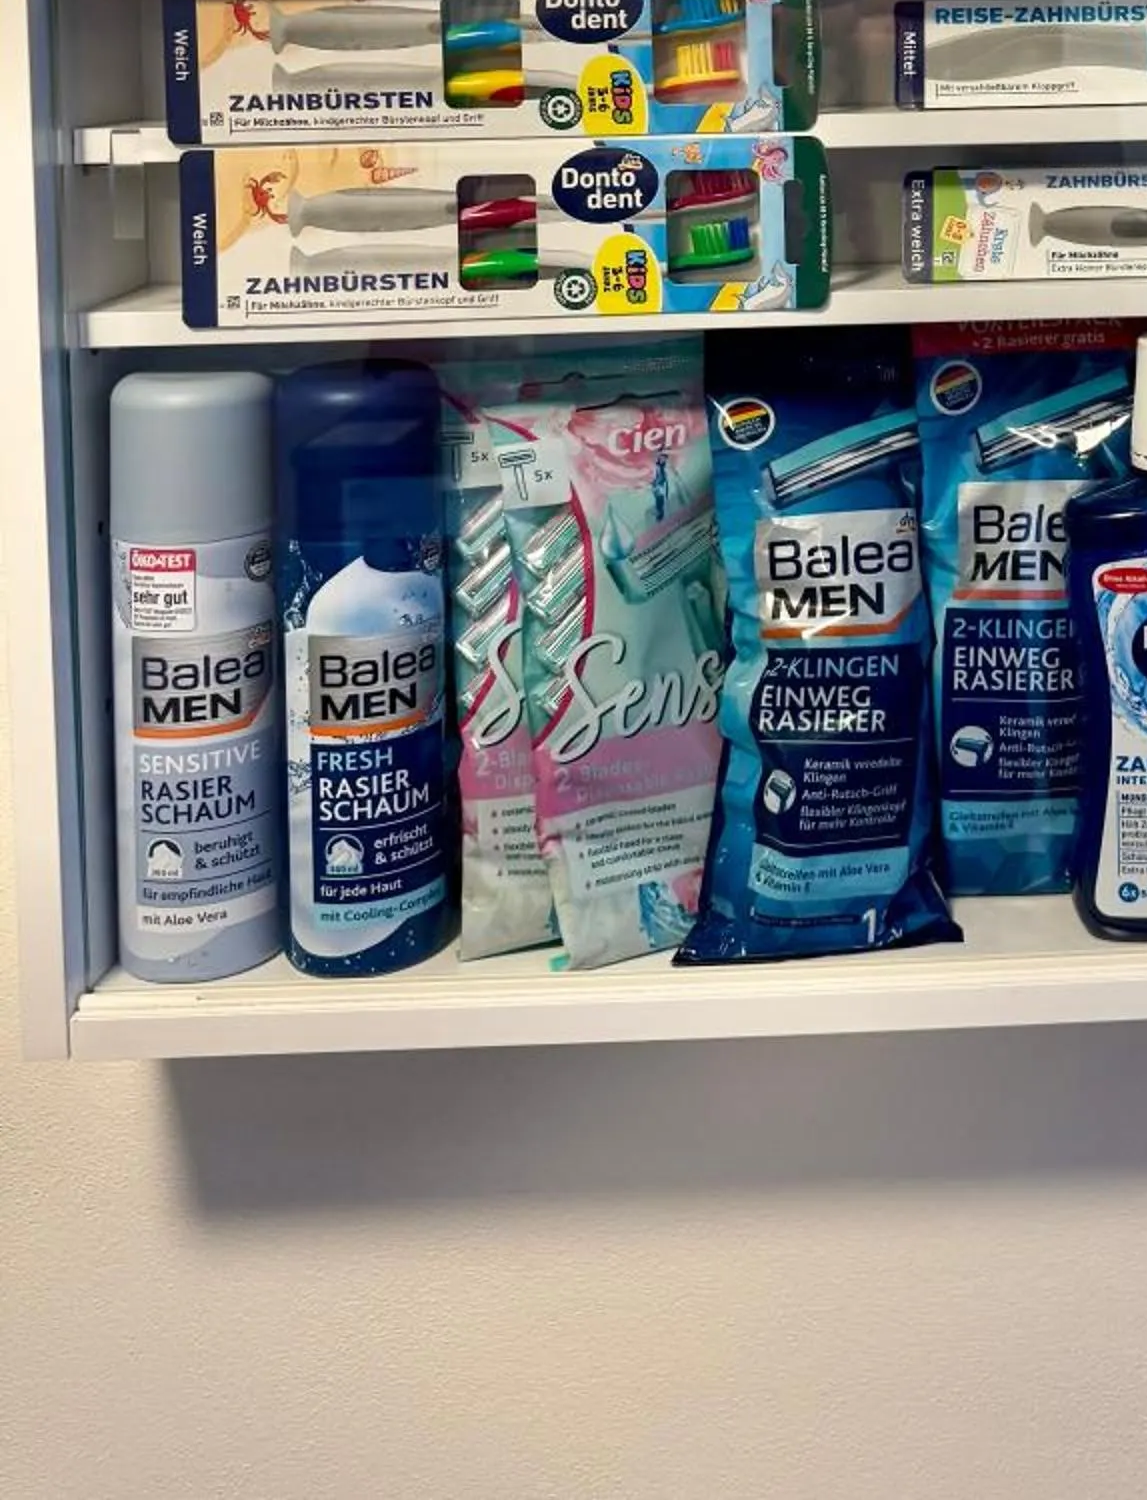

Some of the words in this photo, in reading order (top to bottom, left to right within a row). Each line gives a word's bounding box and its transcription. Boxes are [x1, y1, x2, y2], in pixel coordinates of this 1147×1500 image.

[571, 9, 628, 29] dent
[174, 29, 190, 82] Weich
[903, 31, 916, 76] Mittel
[229, 88, 433, 112] ZAHNBÜRSTEN
[561, 168, 636, 189] Donto
[587, 189, 643, 209] dent
[912, 179, 925, 221] Extra
[192, 213, 208, 266] Weich
[912, 226, 925, 272] weich
[246, 270, 449, 295] ZAHNBÜRSTEN
[608, 422, 687, 456] cien
[471, 451, 489, 462] 5x
[534, 470, 553, 482] 5x
[769, 535, 914, 581] Balea
[164, 590, 188, 606] gut
[771, 582, 885, 619] MEN
[320, 645, 435, 688] Balea
[765, 655, 899, 679] 2-KLINGEN
[954, 646, 1060, 669] EINWEG
[141, 651, 264, 691] Balea
[953, 669, 1074, 691] RASIERER
[143, 688, 241, 723] MEN
[321, 682, 417, 721] MEN
[760, 685, 871, 708] EINWEG
[758, 709, 886, 733] RASIERER
[999, 727, 1040, 739] Klingen
[140, 741, 261, 775] SENSITIVE
[317, 748, 393, 772] FRESH
[804, 758, 851, 770] Keramik
[141, 775, 232, 801] RASIER
[319, 769, 409, 799] RASIER
[803, 772, 847, 784] Klingen
[141, 790, 256, 824] SCHAUM
[319, 784, 429, 821] SCHAUM
[374, 823, 428, 849] erfrischt
[799, 819, 816, 831] für
[818, 818, 847, 830] mehr
[194, 831, 254, 855] beruhigt
[375, 852, 388, 864] &
[390, 838, 434, 861] schützt
[195, 856, 209, 869] &
[212, 844, 260, 867] schützt
[839, 864, 863, 877] Aloe
[866, 862, 890, 874] Vera
[143, 888, 160, 900] für
[161, 879, 244, 902] empfindliche
[320, 885, 338, 897] für
[340, 884, 367, 901] jede
[370, 878, 403, 895] Haut
[142, 913, 161, 926] mit
[164, 911, 193, 926] Aloe
[198, 909, 228, 923] Vera
[320, 910, 341, 922] mit
